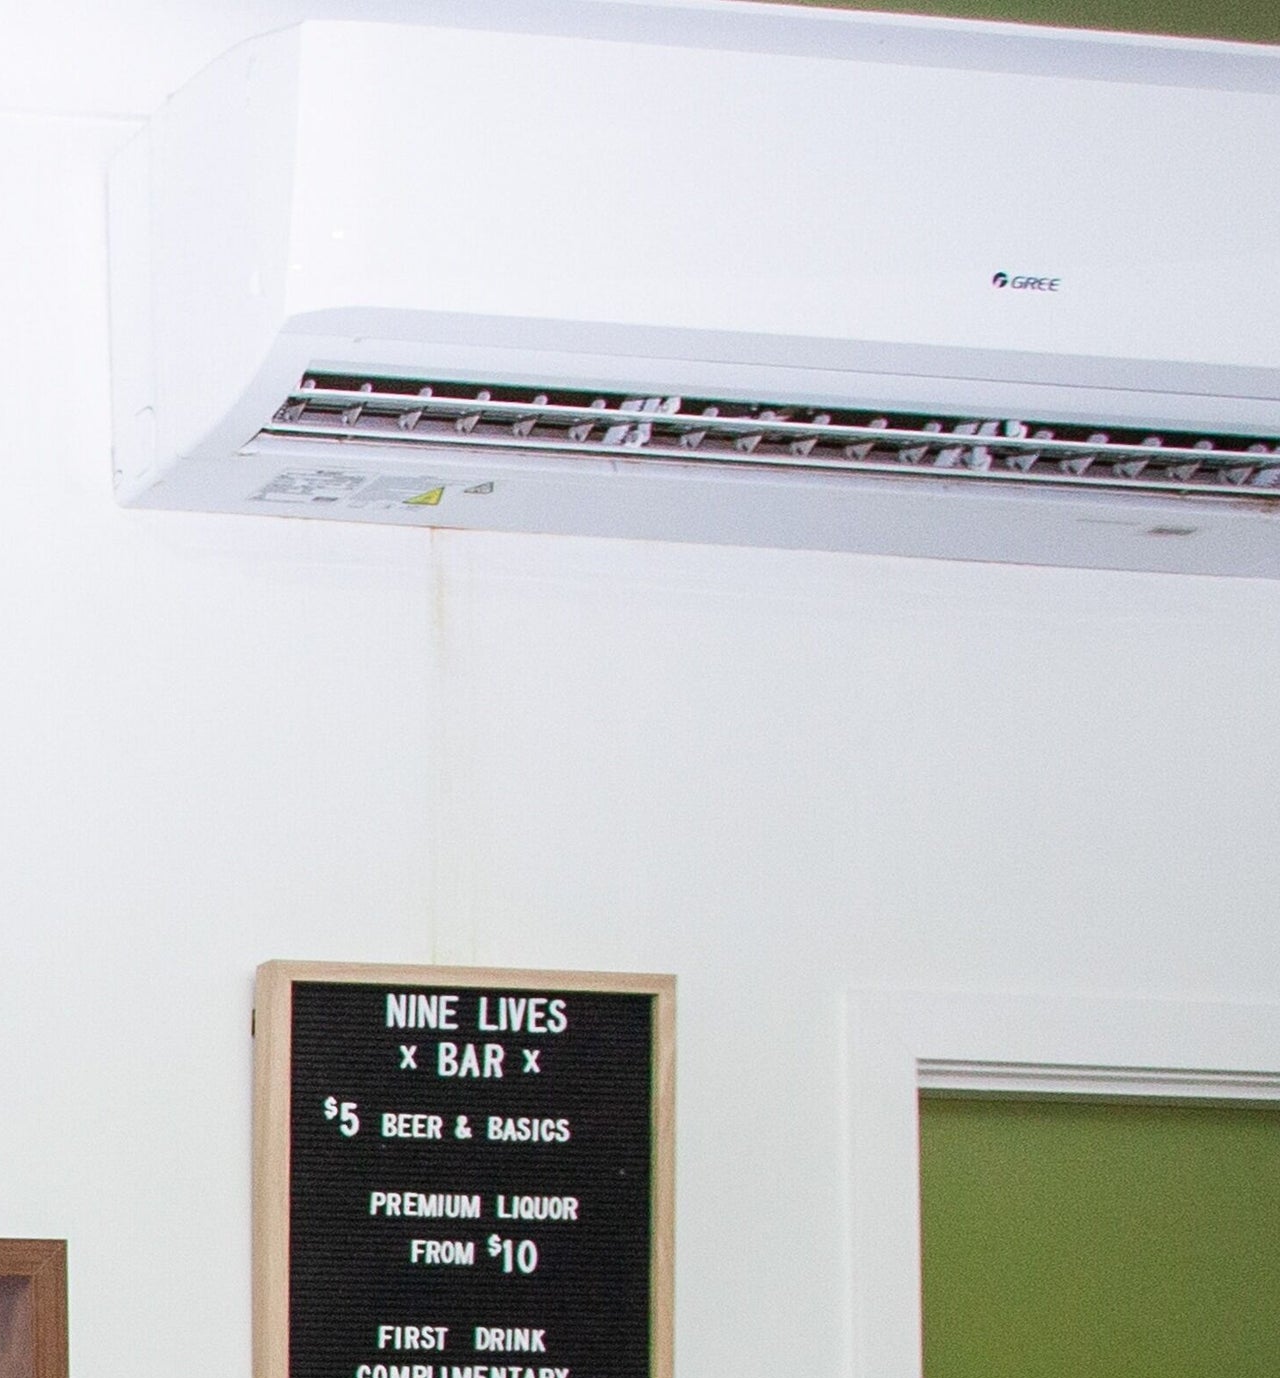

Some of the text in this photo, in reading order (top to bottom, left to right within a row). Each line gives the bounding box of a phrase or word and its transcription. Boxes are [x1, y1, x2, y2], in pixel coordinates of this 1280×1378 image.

[1011, 275, 1062, 292] GREE
[385, 993, 569, 1034] NINE LIVES
[438, 1041, 505, 1078] BAR
[323, 1096, 571, 1143] $5 BEER & BASICS
[369, 1191, 579, 1221] PREMIUM LIQUOR
[410, 1233, 539, 1274] FROM $10
[377, 1325, 547, 1354] FIRST DRINK
